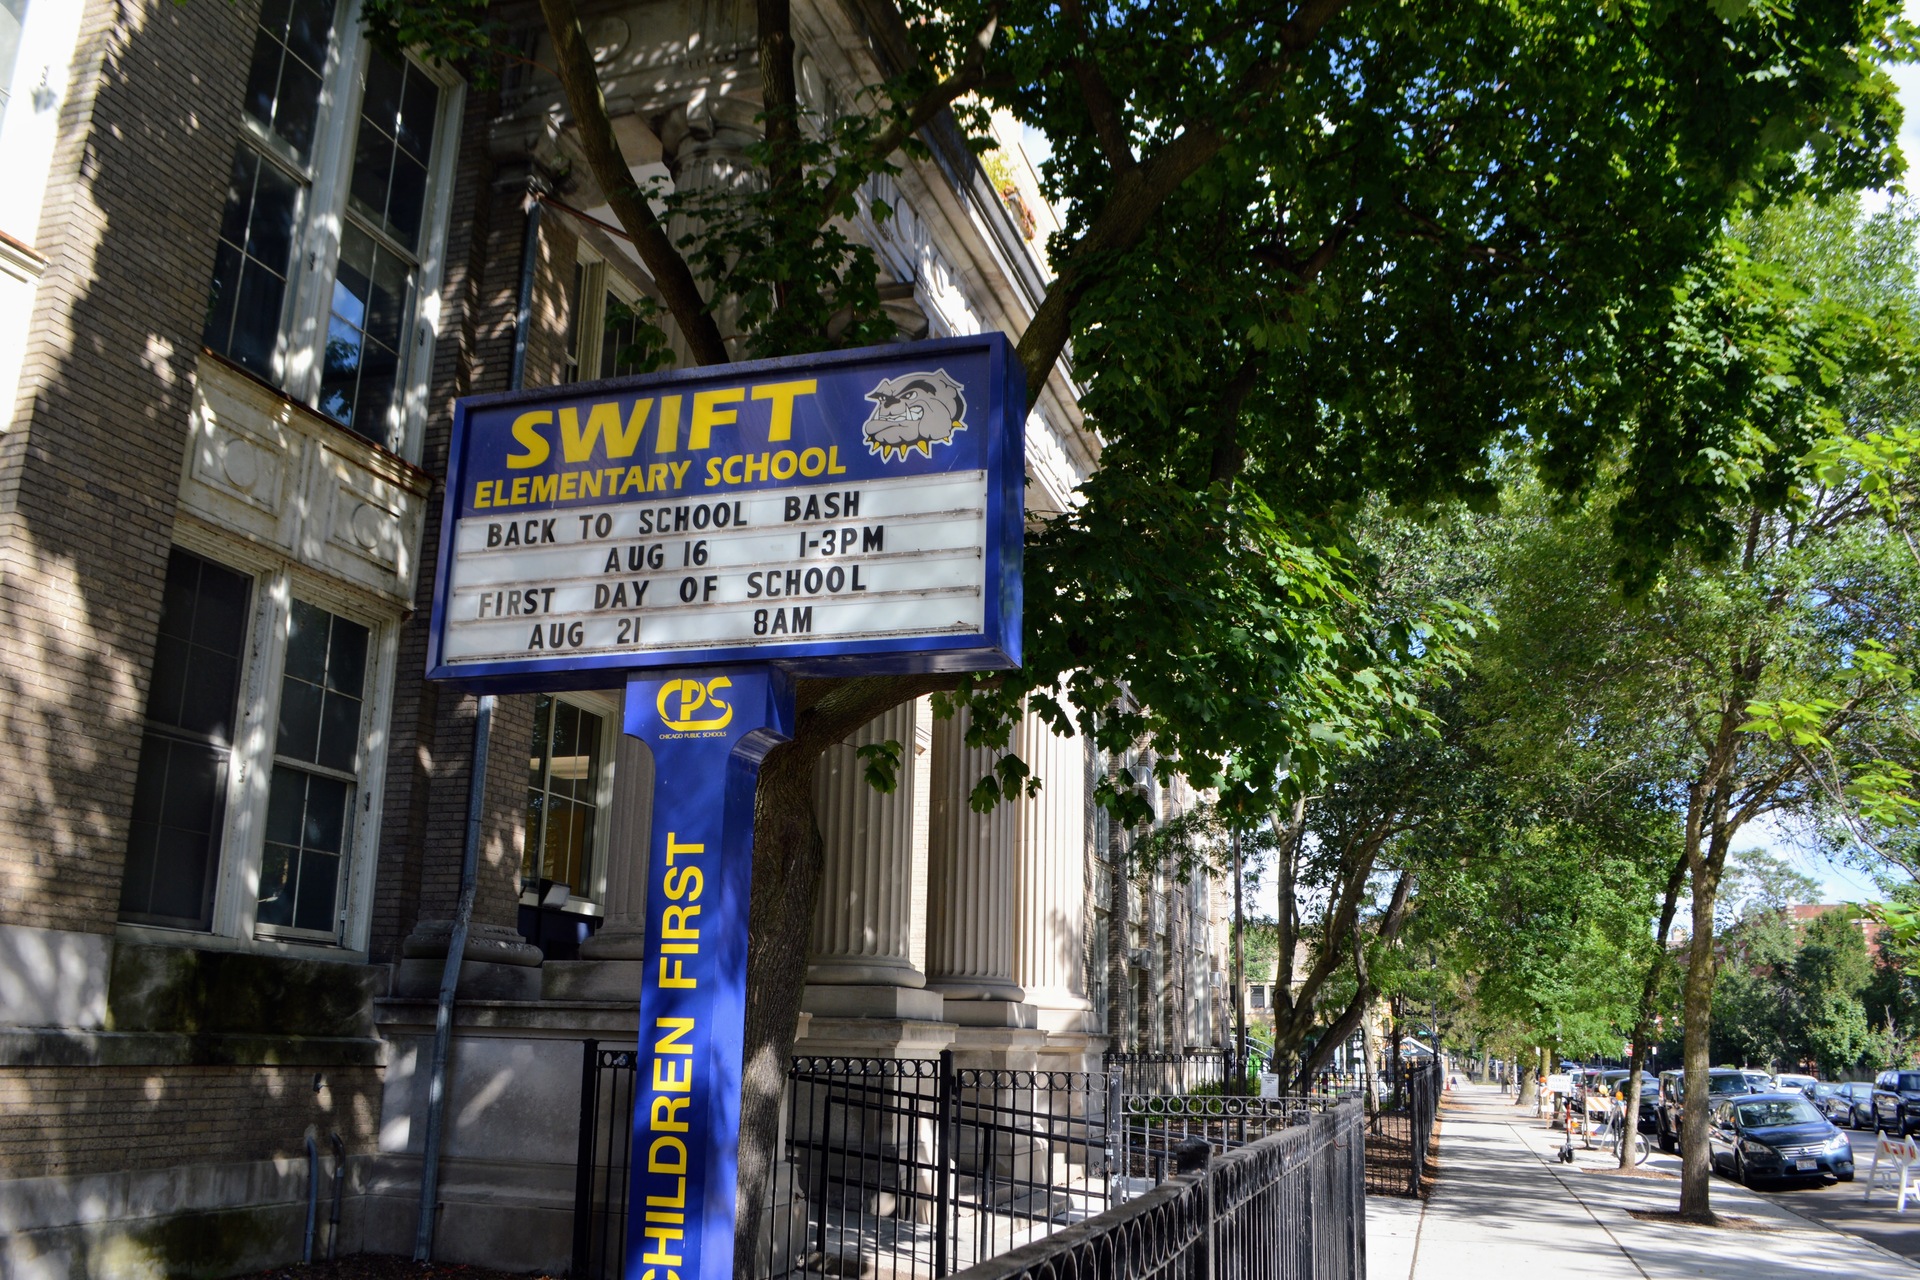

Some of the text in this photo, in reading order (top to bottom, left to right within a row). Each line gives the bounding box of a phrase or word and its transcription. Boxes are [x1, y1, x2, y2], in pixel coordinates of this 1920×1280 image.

[507, 379, 818, 470] SWIFT
[474, 445, 847, 509] ELEMENTARY SCHOOL
[487, 491, 860, 548] BACK TO SCHOOL BASH
[604, 525, 884, 573] AUG 16 1-3PM
[479, 565, 866, 618] FIRST DAY OF SCHOOL
[528, 606, 813, 649] AUG 21 8AM
[656, 676, 733, 732] CPS
[658, 832, 705, 989] FIRST
